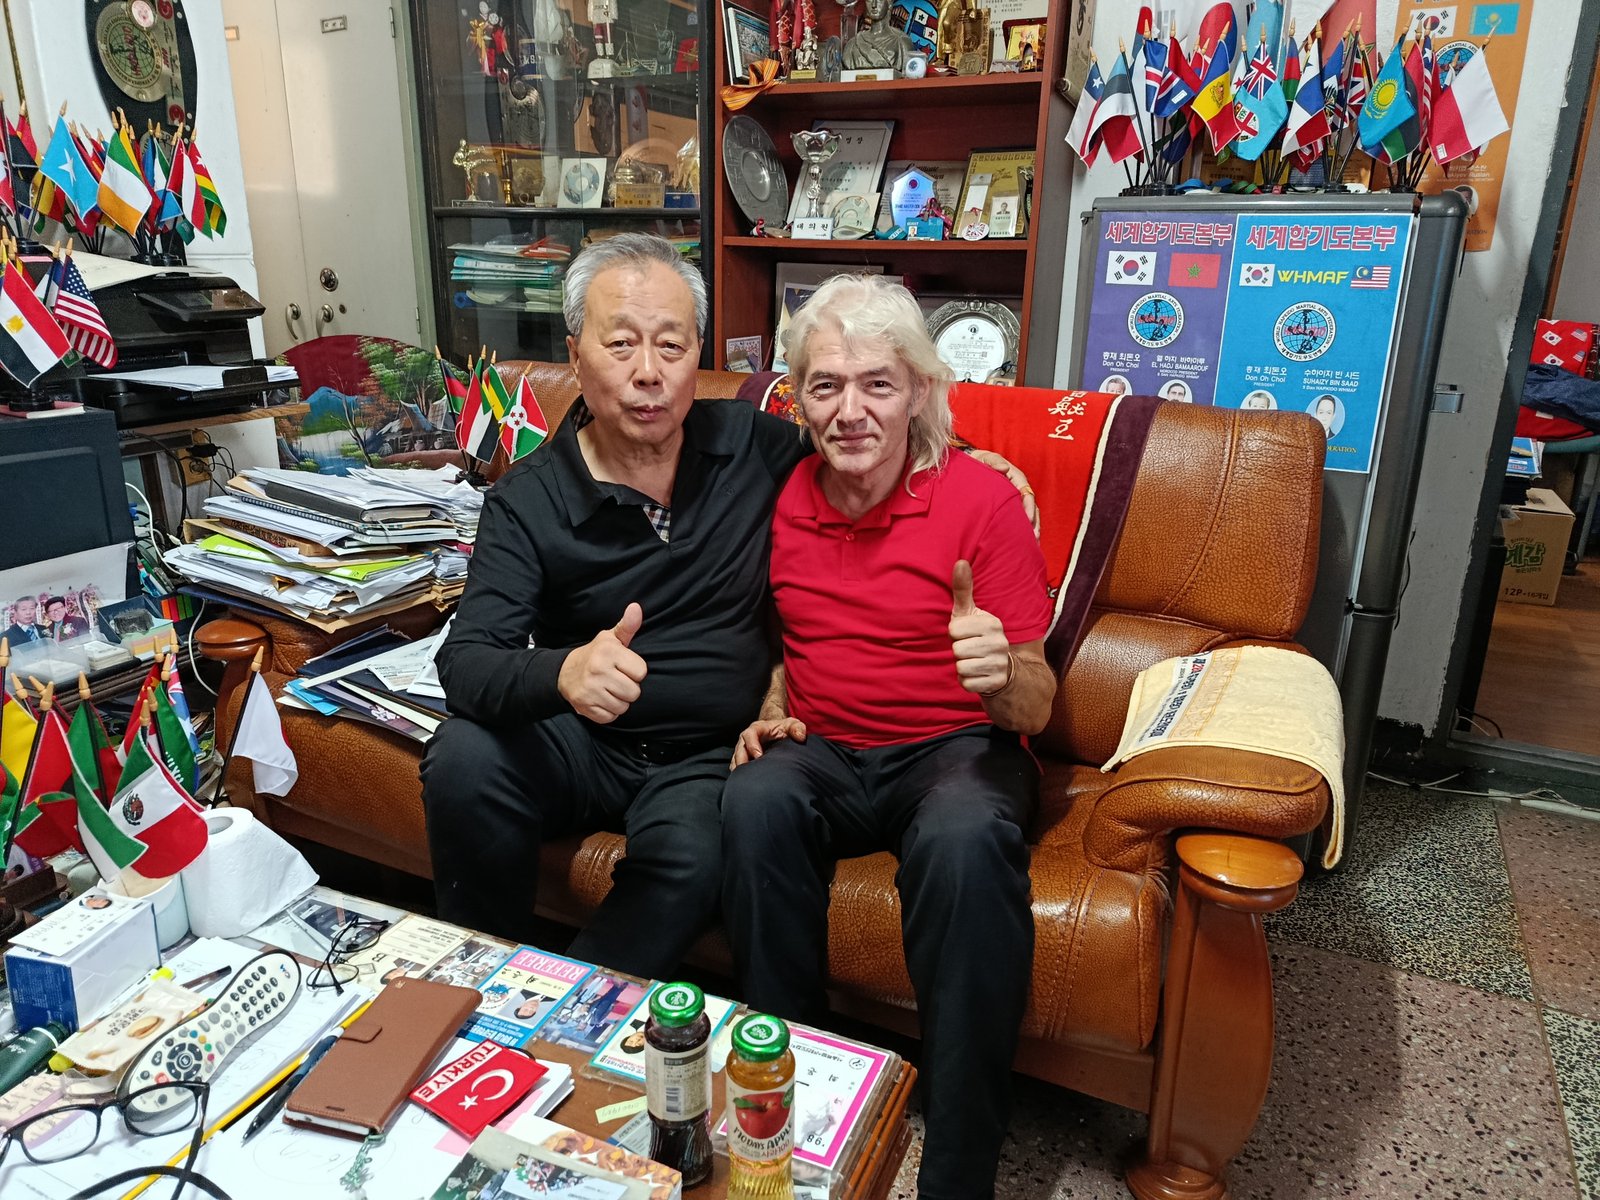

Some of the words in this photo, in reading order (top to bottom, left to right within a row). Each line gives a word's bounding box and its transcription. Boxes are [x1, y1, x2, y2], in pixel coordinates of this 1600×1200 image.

[1105, 221, 1233, 246] 세계합기도본부
[1246, 224, 1397, 251] 세계합기도본부
[1277, 270, 1349, 284] WHMAF
[1318, 307, 1329, 317] ARTS
[1175, 364, 1209, 372] BAMAAROUF
[1341, 379, 1359, 387] SAAD
[515, 953, 585, 981] REFEREE
